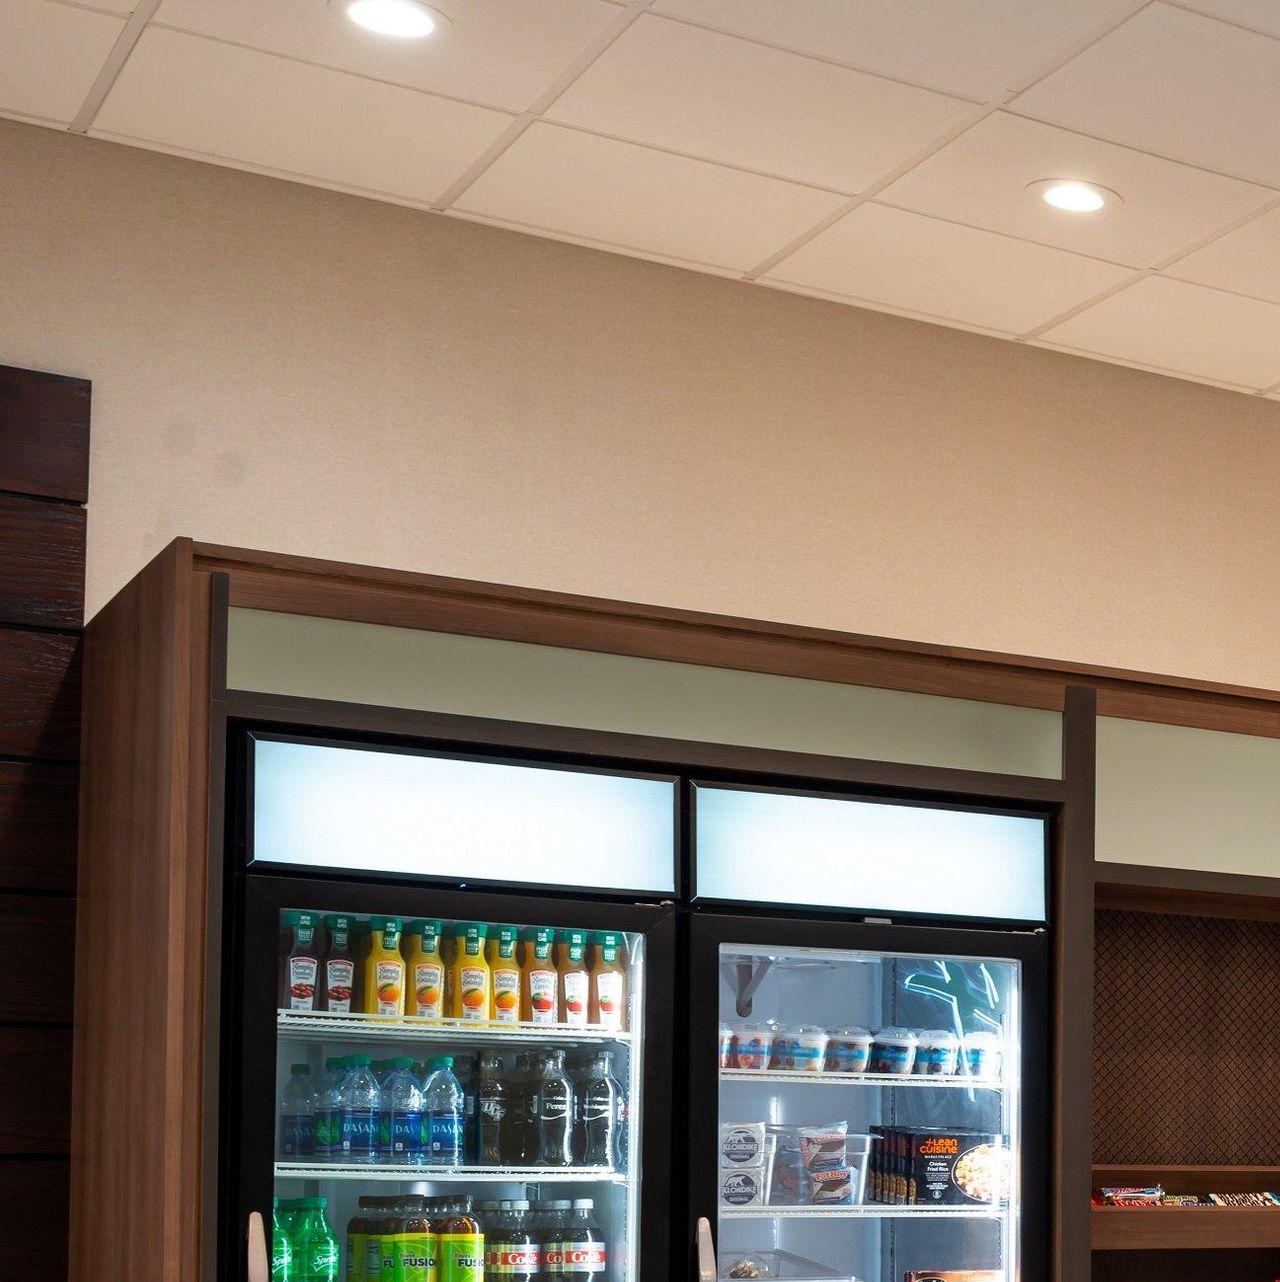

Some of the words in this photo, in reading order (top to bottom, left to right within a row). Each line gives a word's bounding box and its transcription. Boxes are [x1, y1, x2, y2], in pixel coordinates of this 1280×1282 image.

[343, 1123, 378, 1135] DASAN
[432, 1123, 463, 1134] DASAN
[402, 1257, 436, 1268] FUSIO
[457, 1257, 485, 1268] FUSIO
